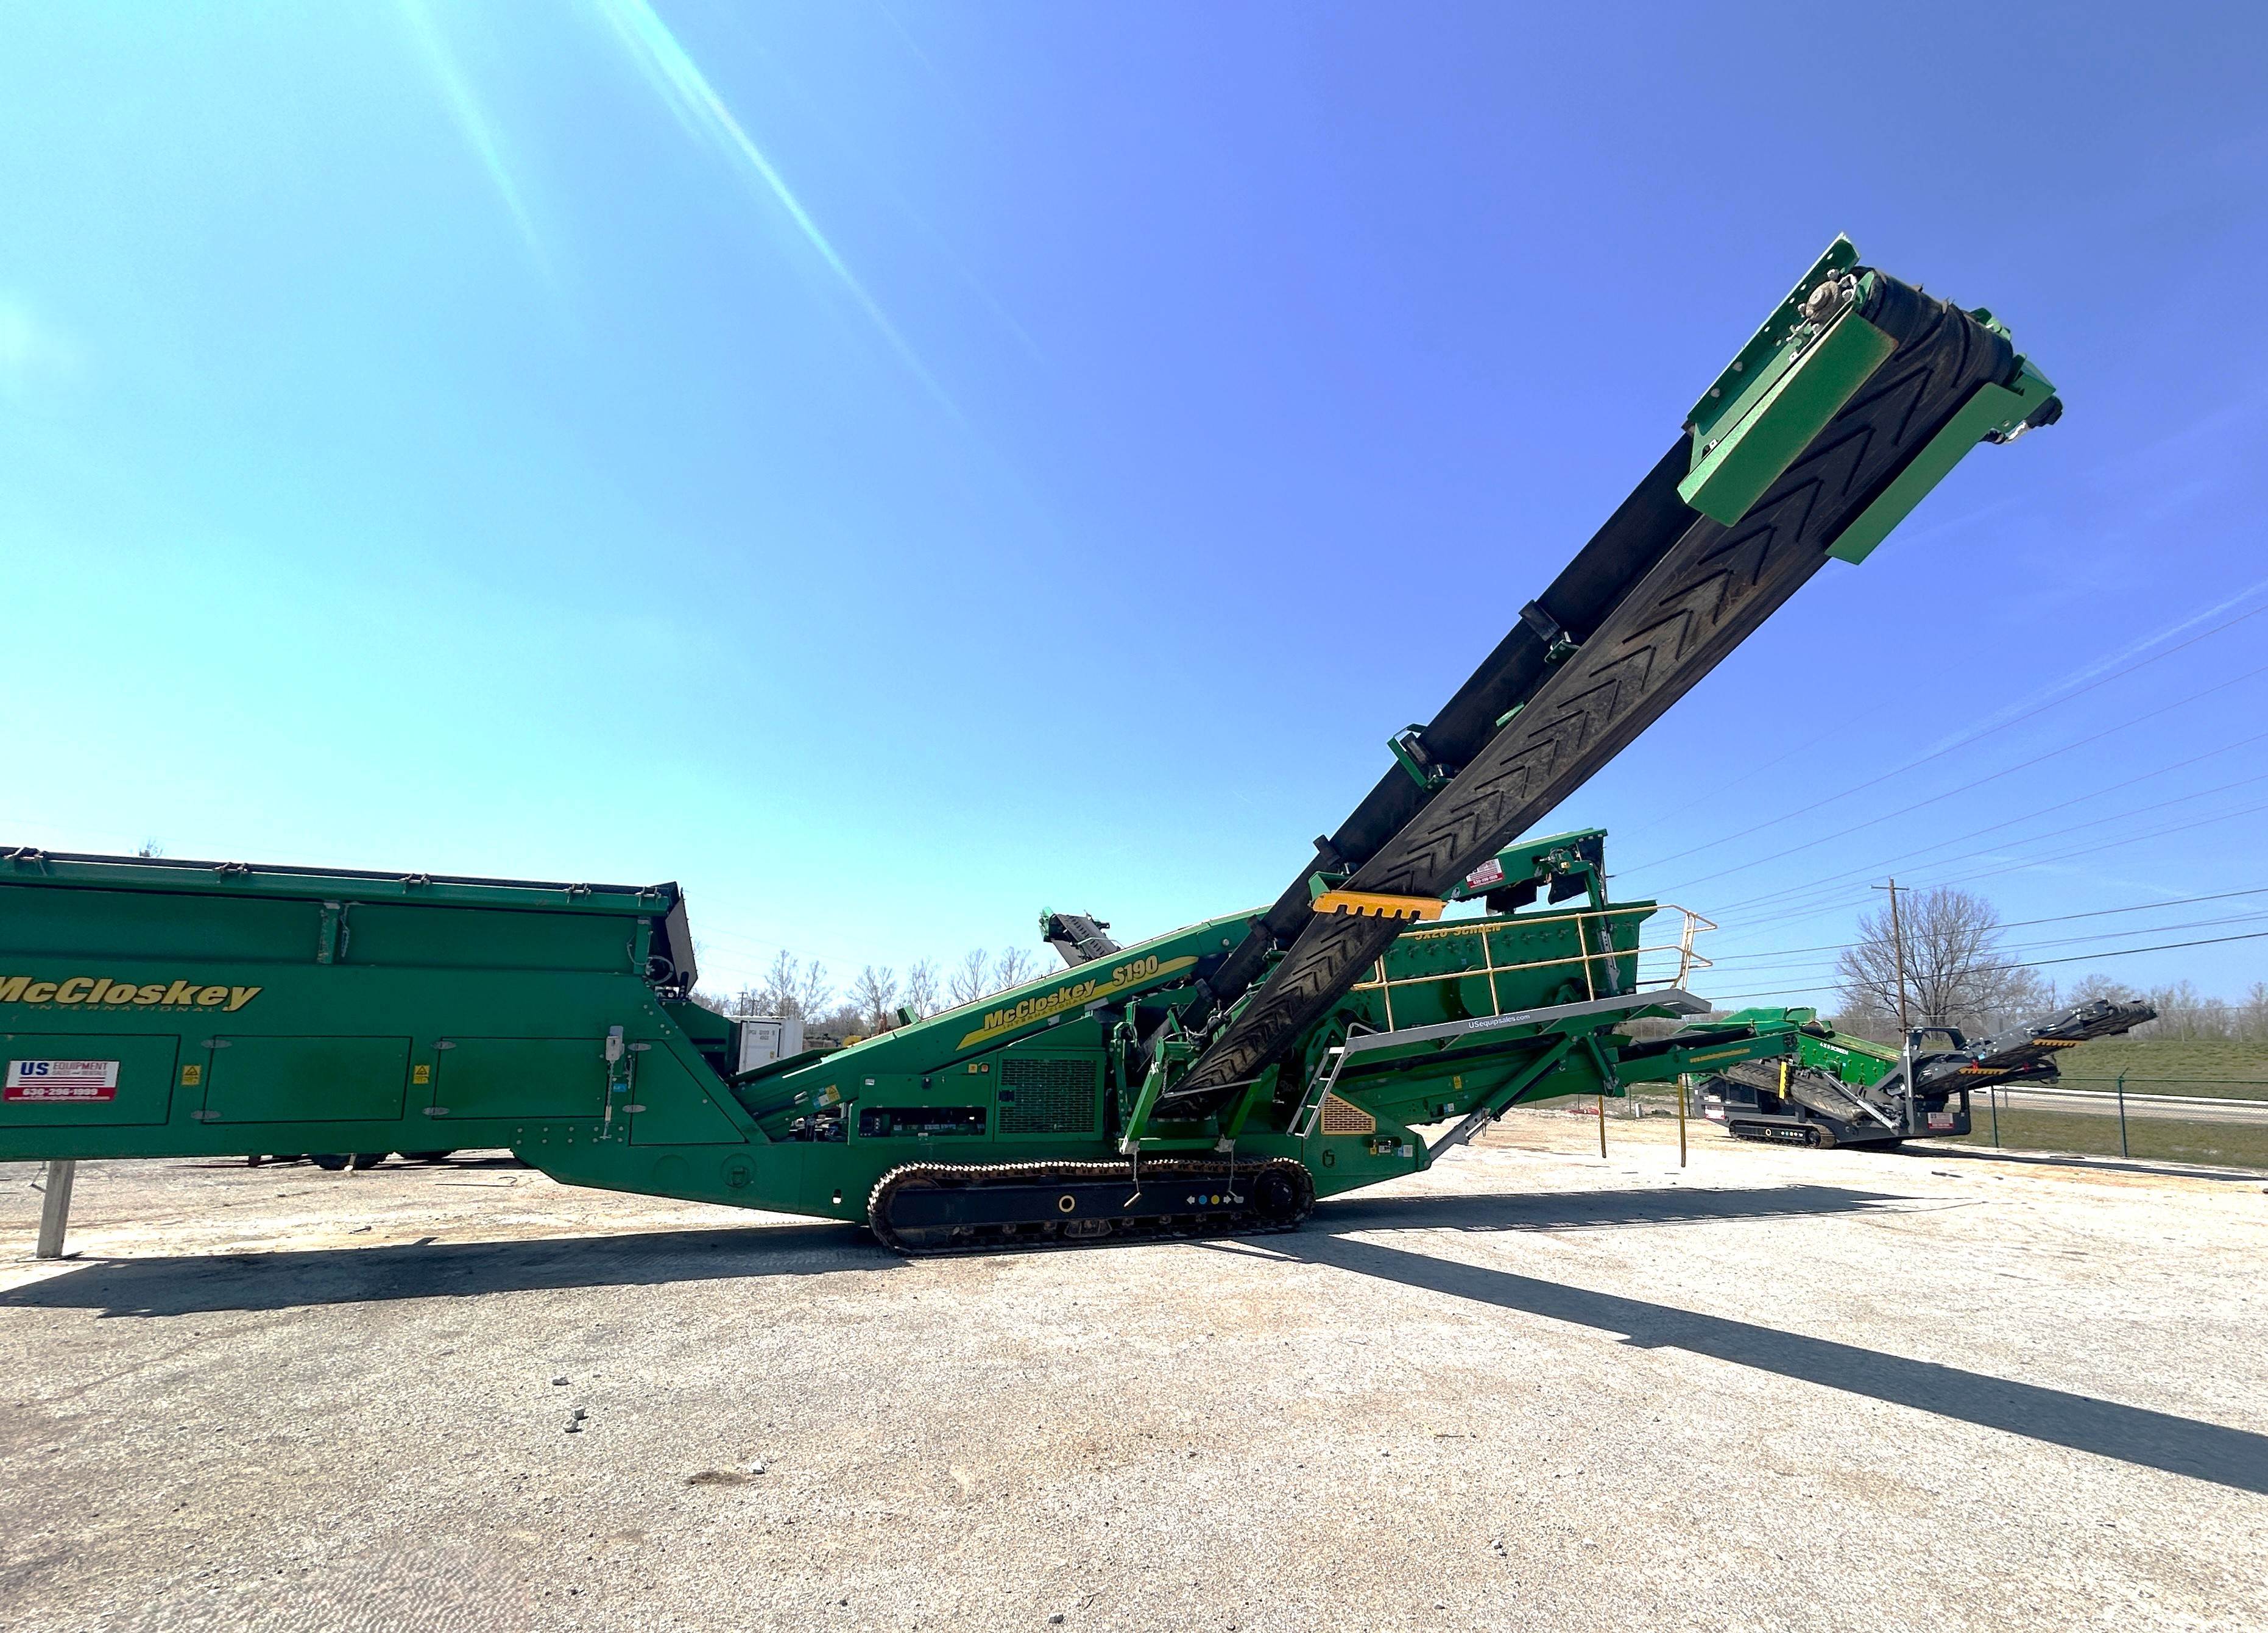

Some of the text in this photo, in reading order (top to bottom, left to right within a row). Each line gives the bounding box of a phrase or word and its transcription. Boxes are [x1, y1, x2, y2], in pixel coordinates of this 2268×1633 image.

[0, 976, 263, 1011] McCloskey
[984, 955, 1159, 1031] McCloskey S190
[29, 1004, 216, 1013] INTERNATIONAL
[1003, 995, 1085, 1029] INTERNATIONAL
[1468, 1014, 1530, 1029] USequipsales.com
[21, 1062, 107, 1075] US EQUIPMENT
